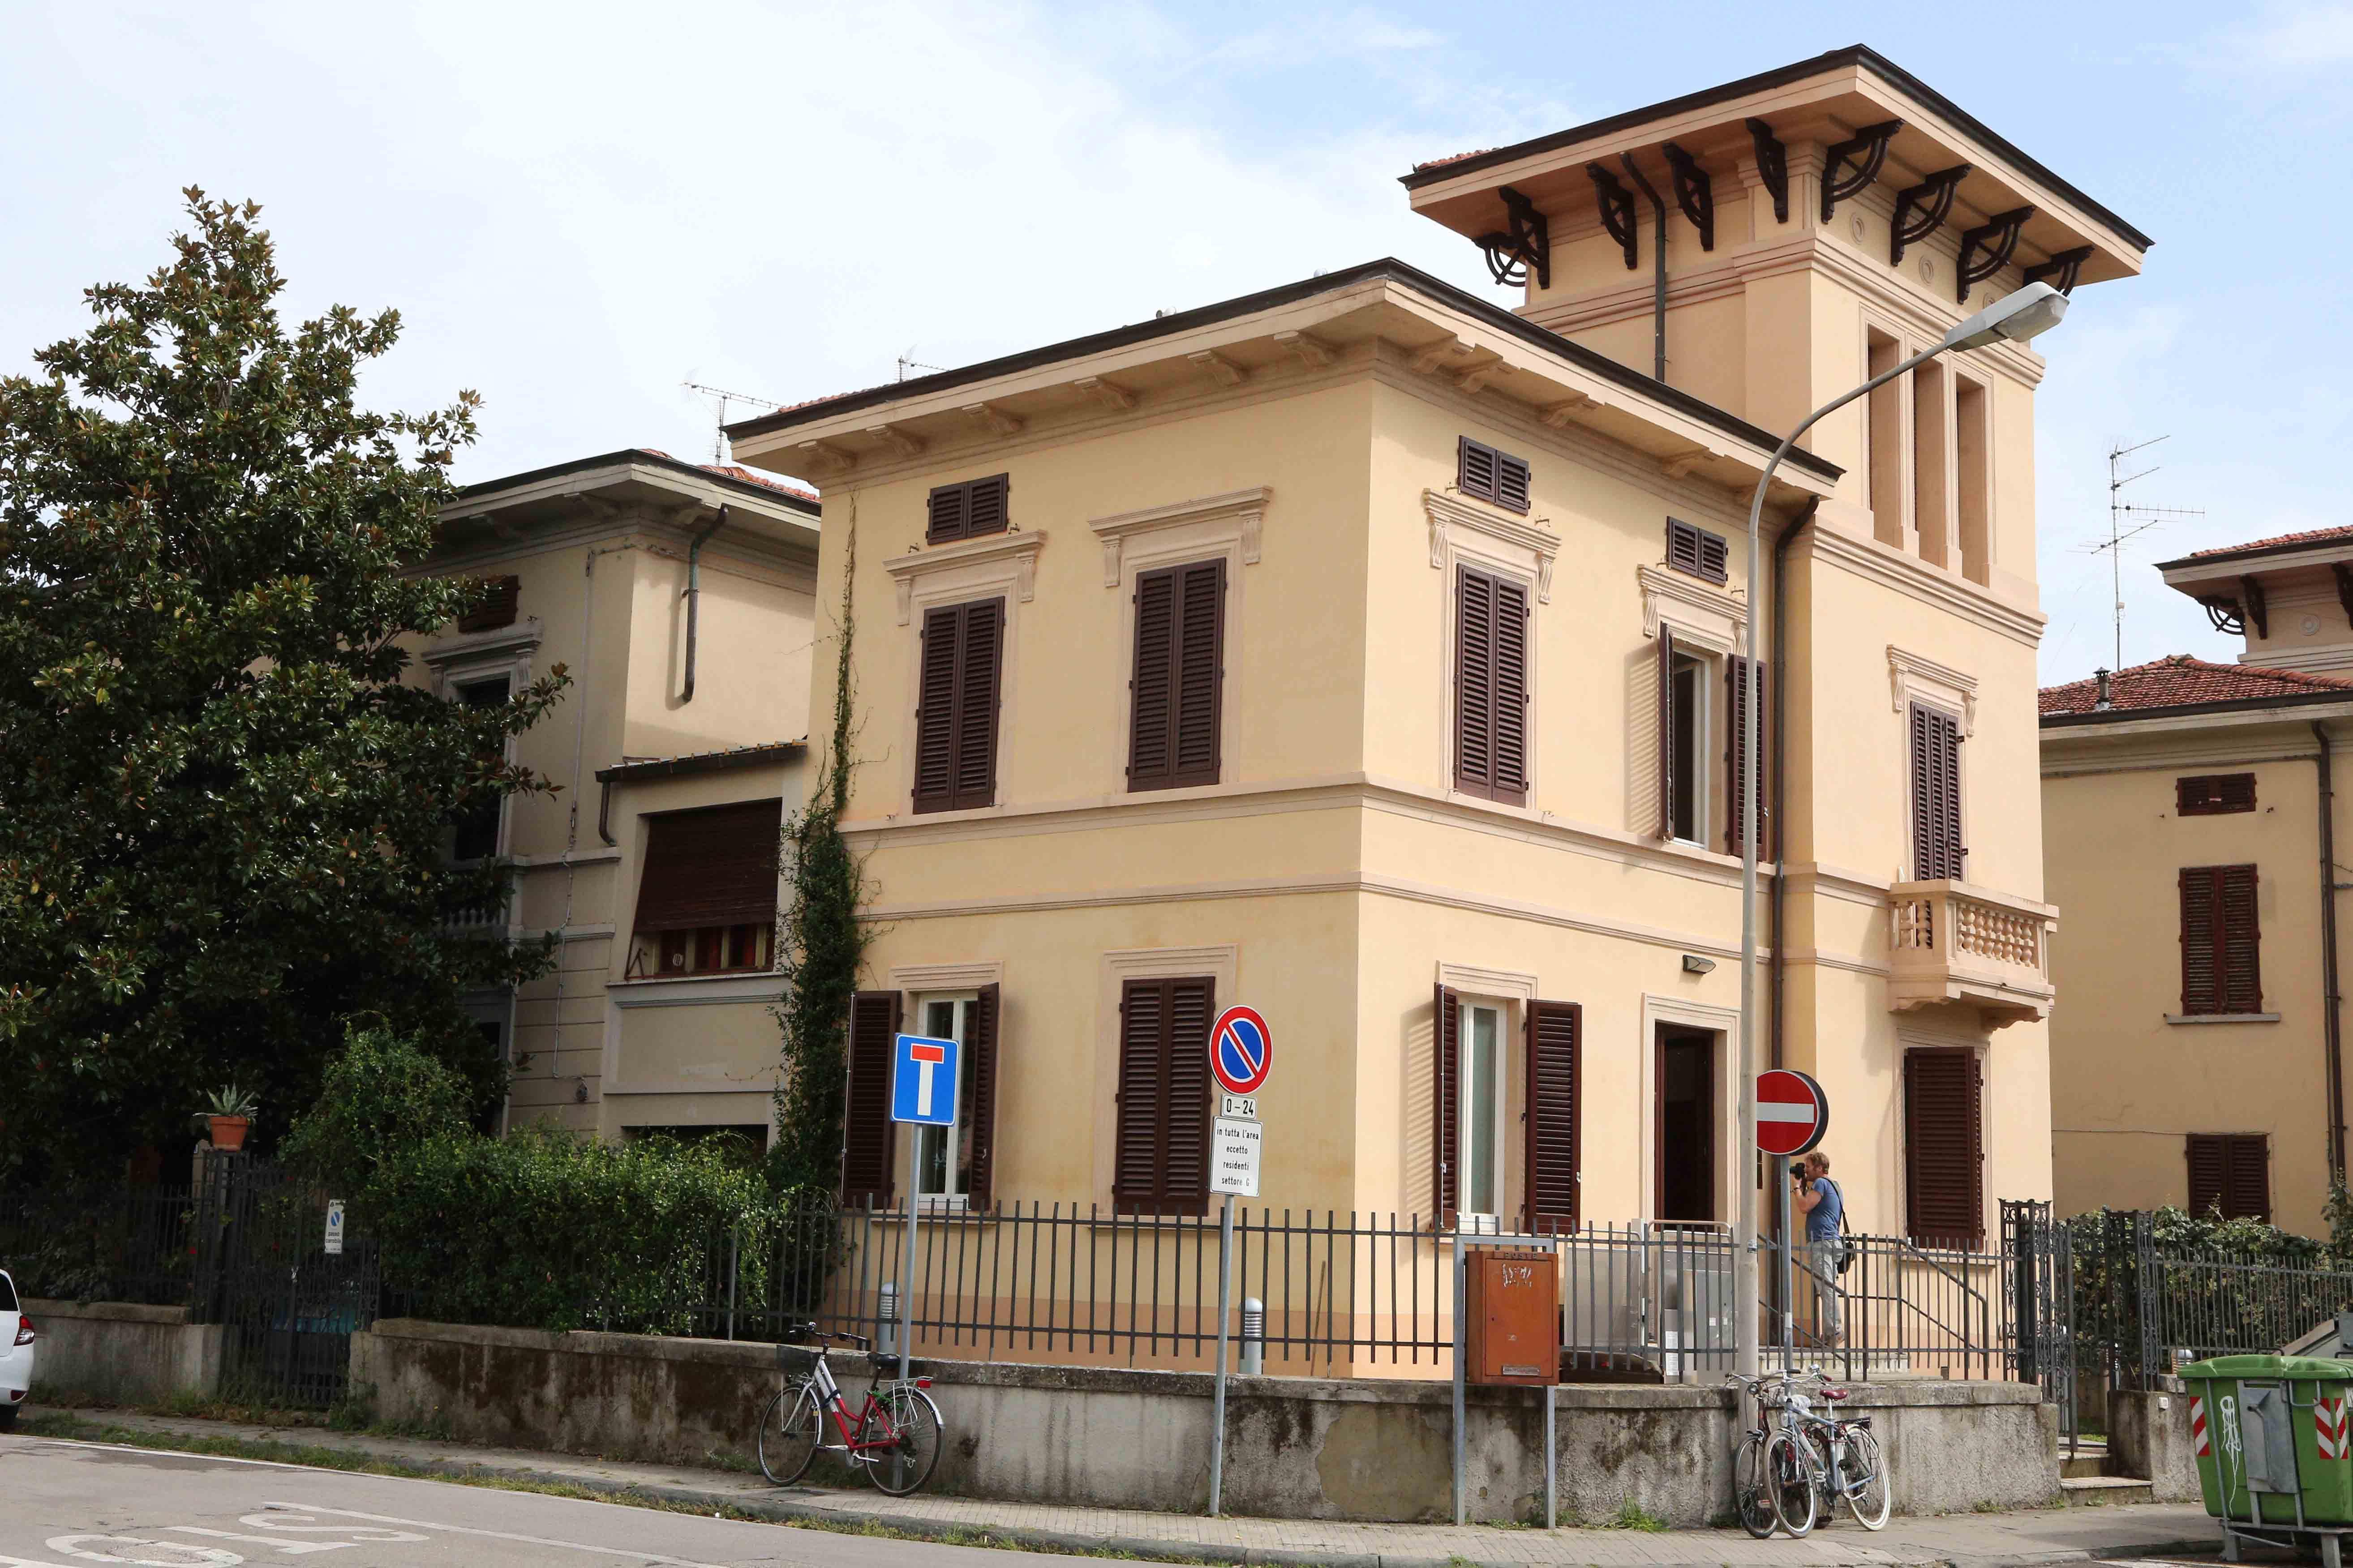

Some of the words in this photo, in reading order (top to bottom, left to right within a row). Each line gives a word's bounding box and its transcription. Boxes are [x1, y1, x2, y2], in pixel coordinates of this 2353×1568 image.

[1217, 1126, 1222, 1135] in
[1225, 1128, 1240, 1137] tutta
[1242, 1129, 1259, 1140] l'area
[1226, 1145, 1248, 1154] eccetto
[1223, 1161, 1249, 1170] residenti
[1222, 1176, 1243, 1186] settore
